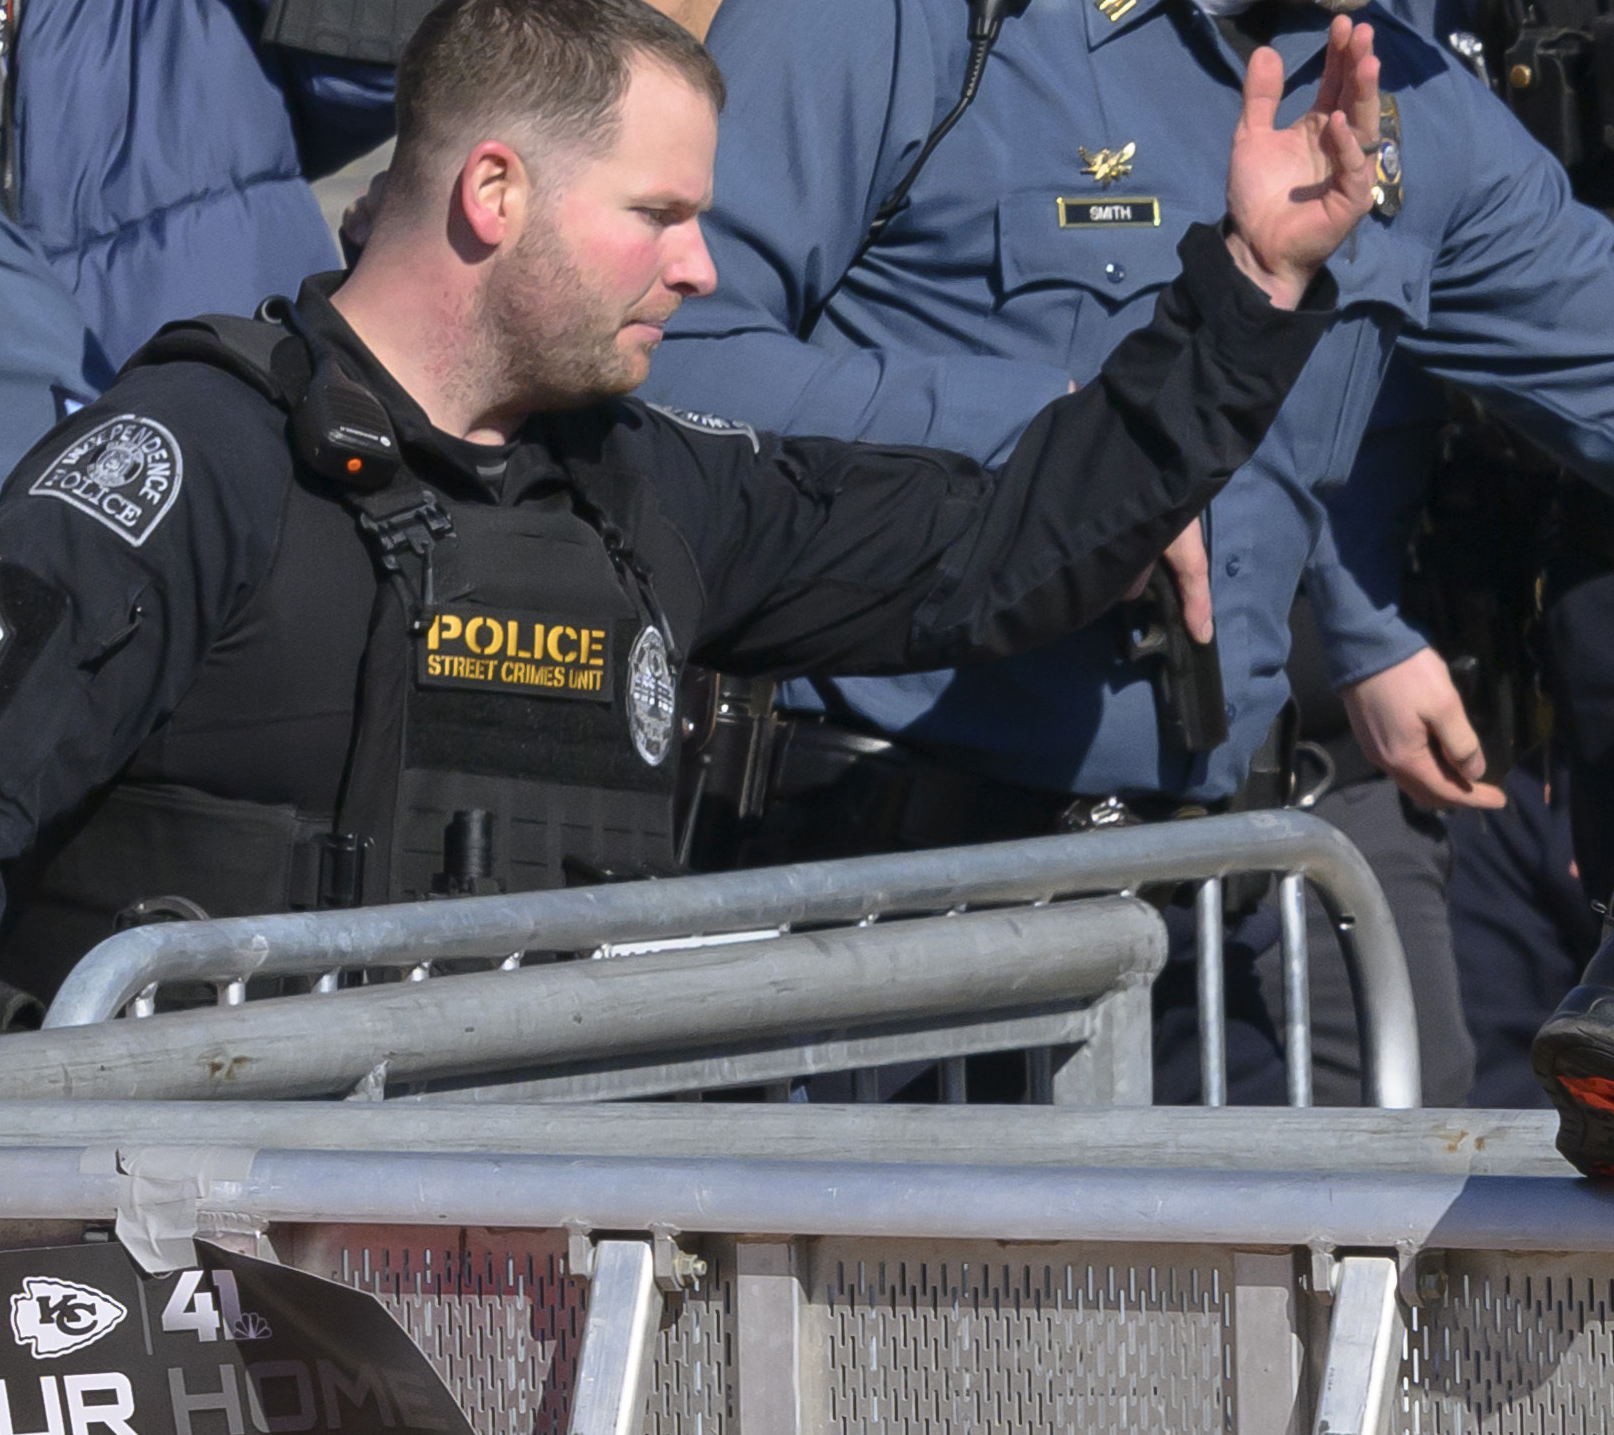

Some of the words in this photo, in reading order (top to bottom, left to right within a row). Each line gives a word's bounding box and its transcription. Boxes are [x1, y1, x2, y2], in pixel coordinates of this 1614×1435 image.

[1089, 205, 1132, 221] SMITH
[427, 614, 606, 666] POLICE
[428, 654, 498, 682] STREET
[500, 662, 565, 689] CRIMES
[568, 669, 603, 691] UNIT
[161, 1269, 244, 1342] 41
